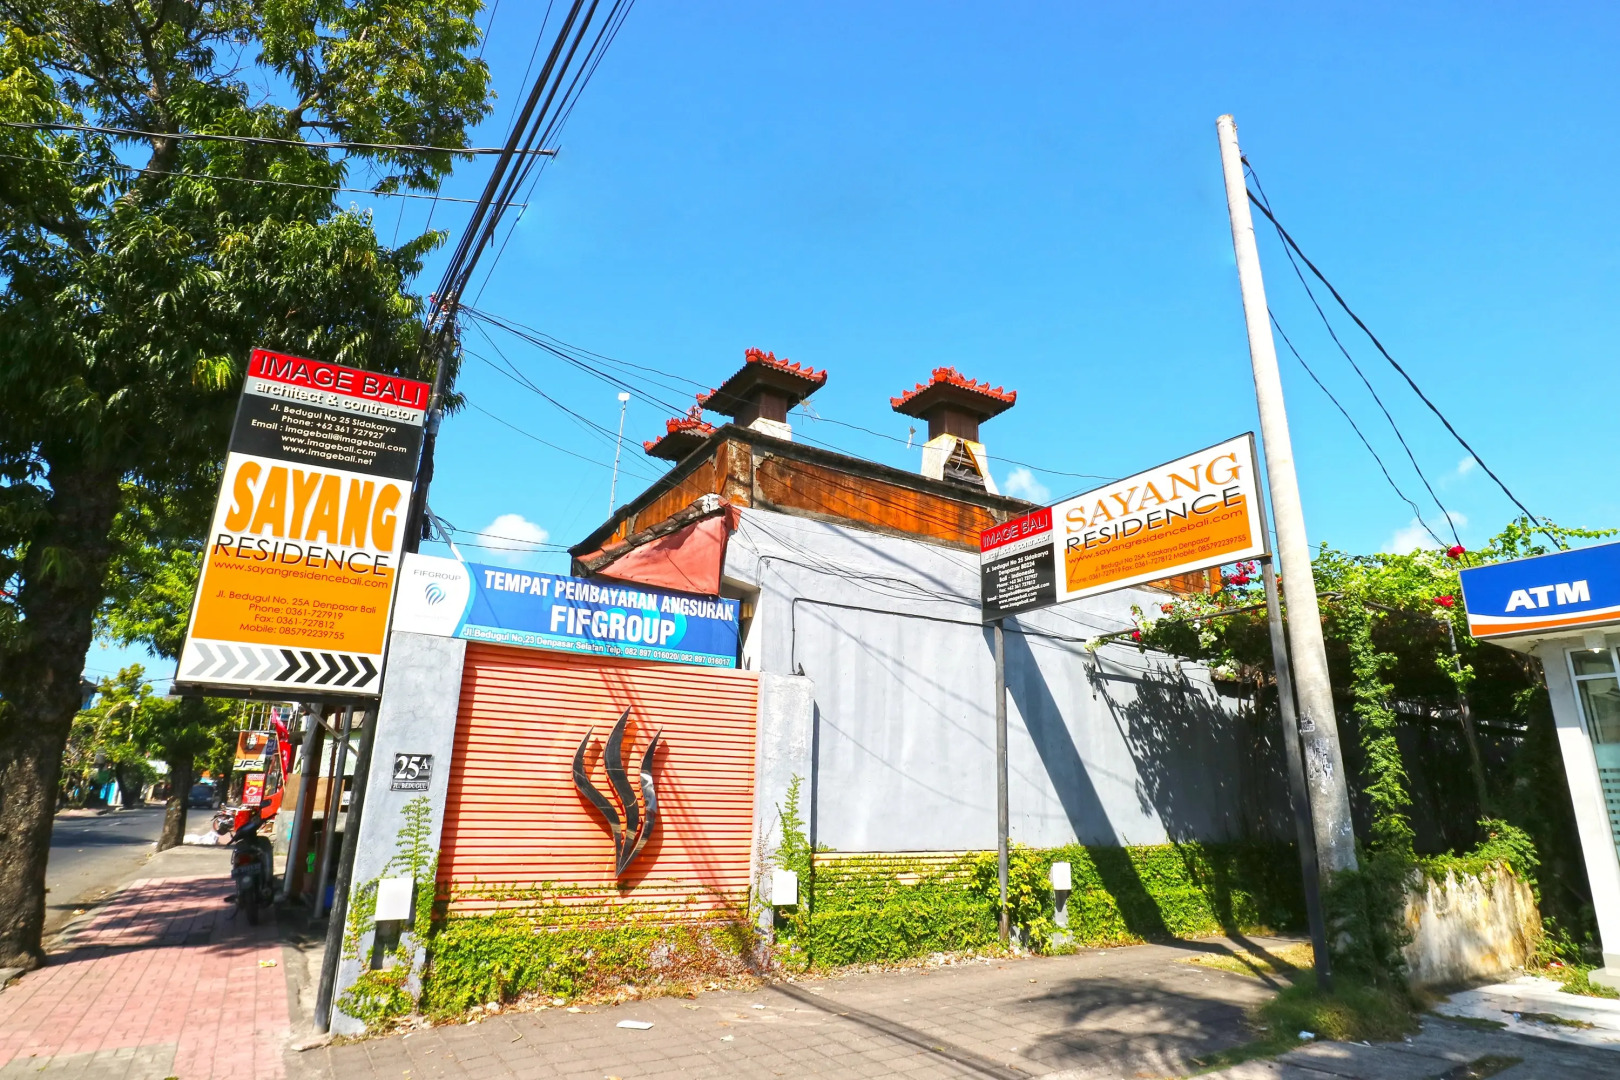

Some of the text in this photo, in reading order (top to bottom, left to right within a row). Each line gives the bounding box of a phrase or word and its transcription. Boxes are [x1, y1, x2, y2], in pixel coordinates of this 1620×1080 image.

[260, 355, 421, 405] IMAGE BALI
[255, 381, 417, 422] architect & contractor
[282, 415, 384, 439] Phone: +62 361 727927
[283, 405, 322, 420] Bedugul
[324, 413, 337, 422] No
[339, 415, 350, 424] 25
[352, 418, 396, 434] Sidakarya
[251, 419, 278, 430] Email
[284, 424, 407, 453] imagebali@imagebali.com
[282, 435, 377, 457] www.imagebali.com
[282, 444, 373, 465] www.imagebali.net
[224, 461, 402, 553] SAYANG
[1065, 452, 1243, 535] SAYANG
[983, 514, 1048, 548] IMAGE BALI
[1066, 485, 1242, 554] RESIDENCE
[1068, 509, 1243, 564] www.sayangresidencebali.com
[1178, 535, 1210, 550] Denpasar
[214, 533, 390, 576] RESIDENCE
[213, 561, 388, 589] www.sayangresidencebali.com
[413, 569, 461, 581] FIFGROUP
[216, 590, 377, 614] Jl. Bedugul No. 25A Denpasar Bali
[484, 569, 734, 621] TEMPAT PEMBAYARAN ANGSURAN
[1504, 579, 1591, 612] ATM
[248, 603, 343, 620] Phone: 0361-727919
[254, 614, 335, 629] Fax: 0361-727812
[549, 604, 676, 645] FIFGROUP
[239, 623, 345, 640] Mobile: 085792239755
[536, 636, 575, 649] Denpasar
[575, 641, 604, 652] Selatan
[624, 647, 638, 655] 082
[639, 649, 652, 657] 897
[681, 653, 693, 661] 082
[694, 655, 706, 663] 897
[707, 656, 730, 666] 016017
